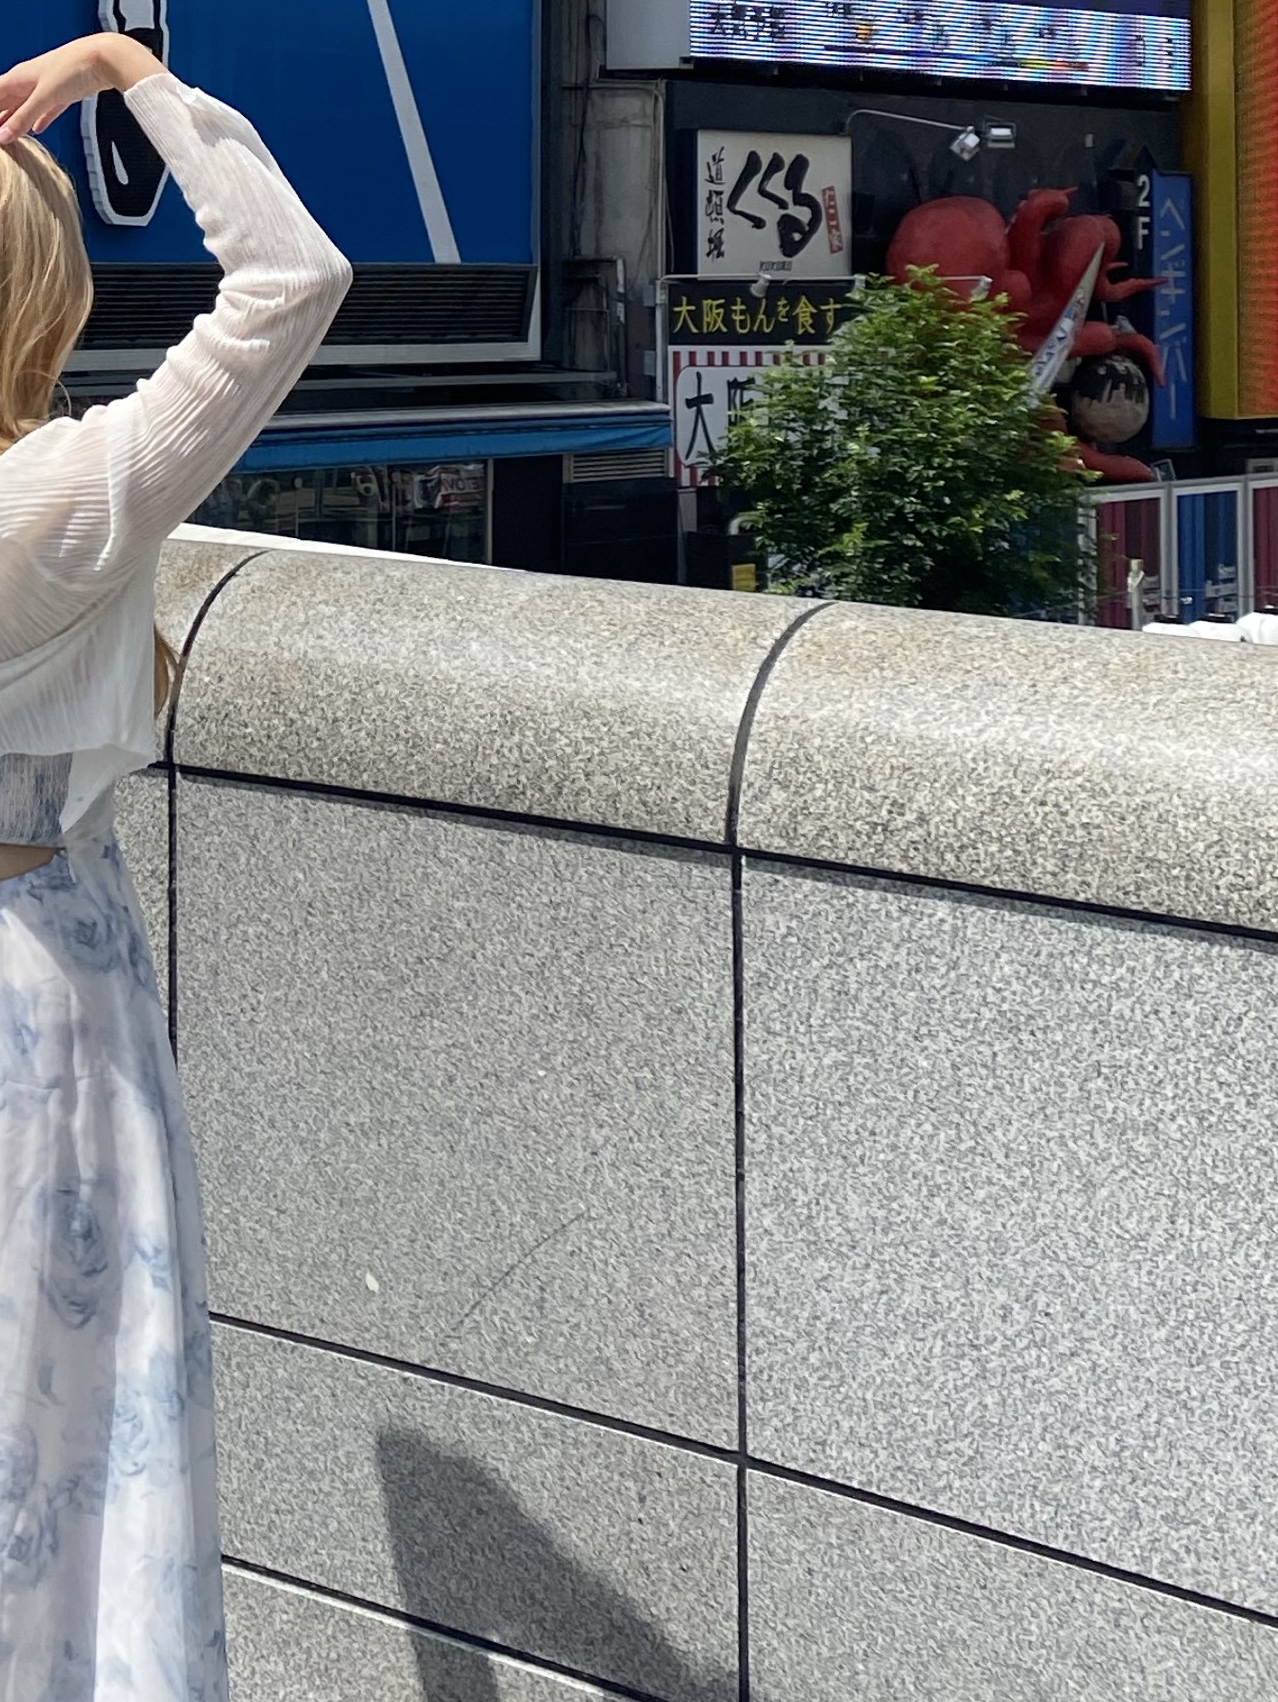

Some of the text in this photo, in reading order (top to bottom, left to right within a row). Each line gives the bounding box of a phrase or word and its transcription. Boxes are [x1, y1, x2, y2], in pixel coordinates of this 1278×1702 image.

[726, 150, 823, 258] くくる
[673, 295, 842, 335] 大阪もんを食す
